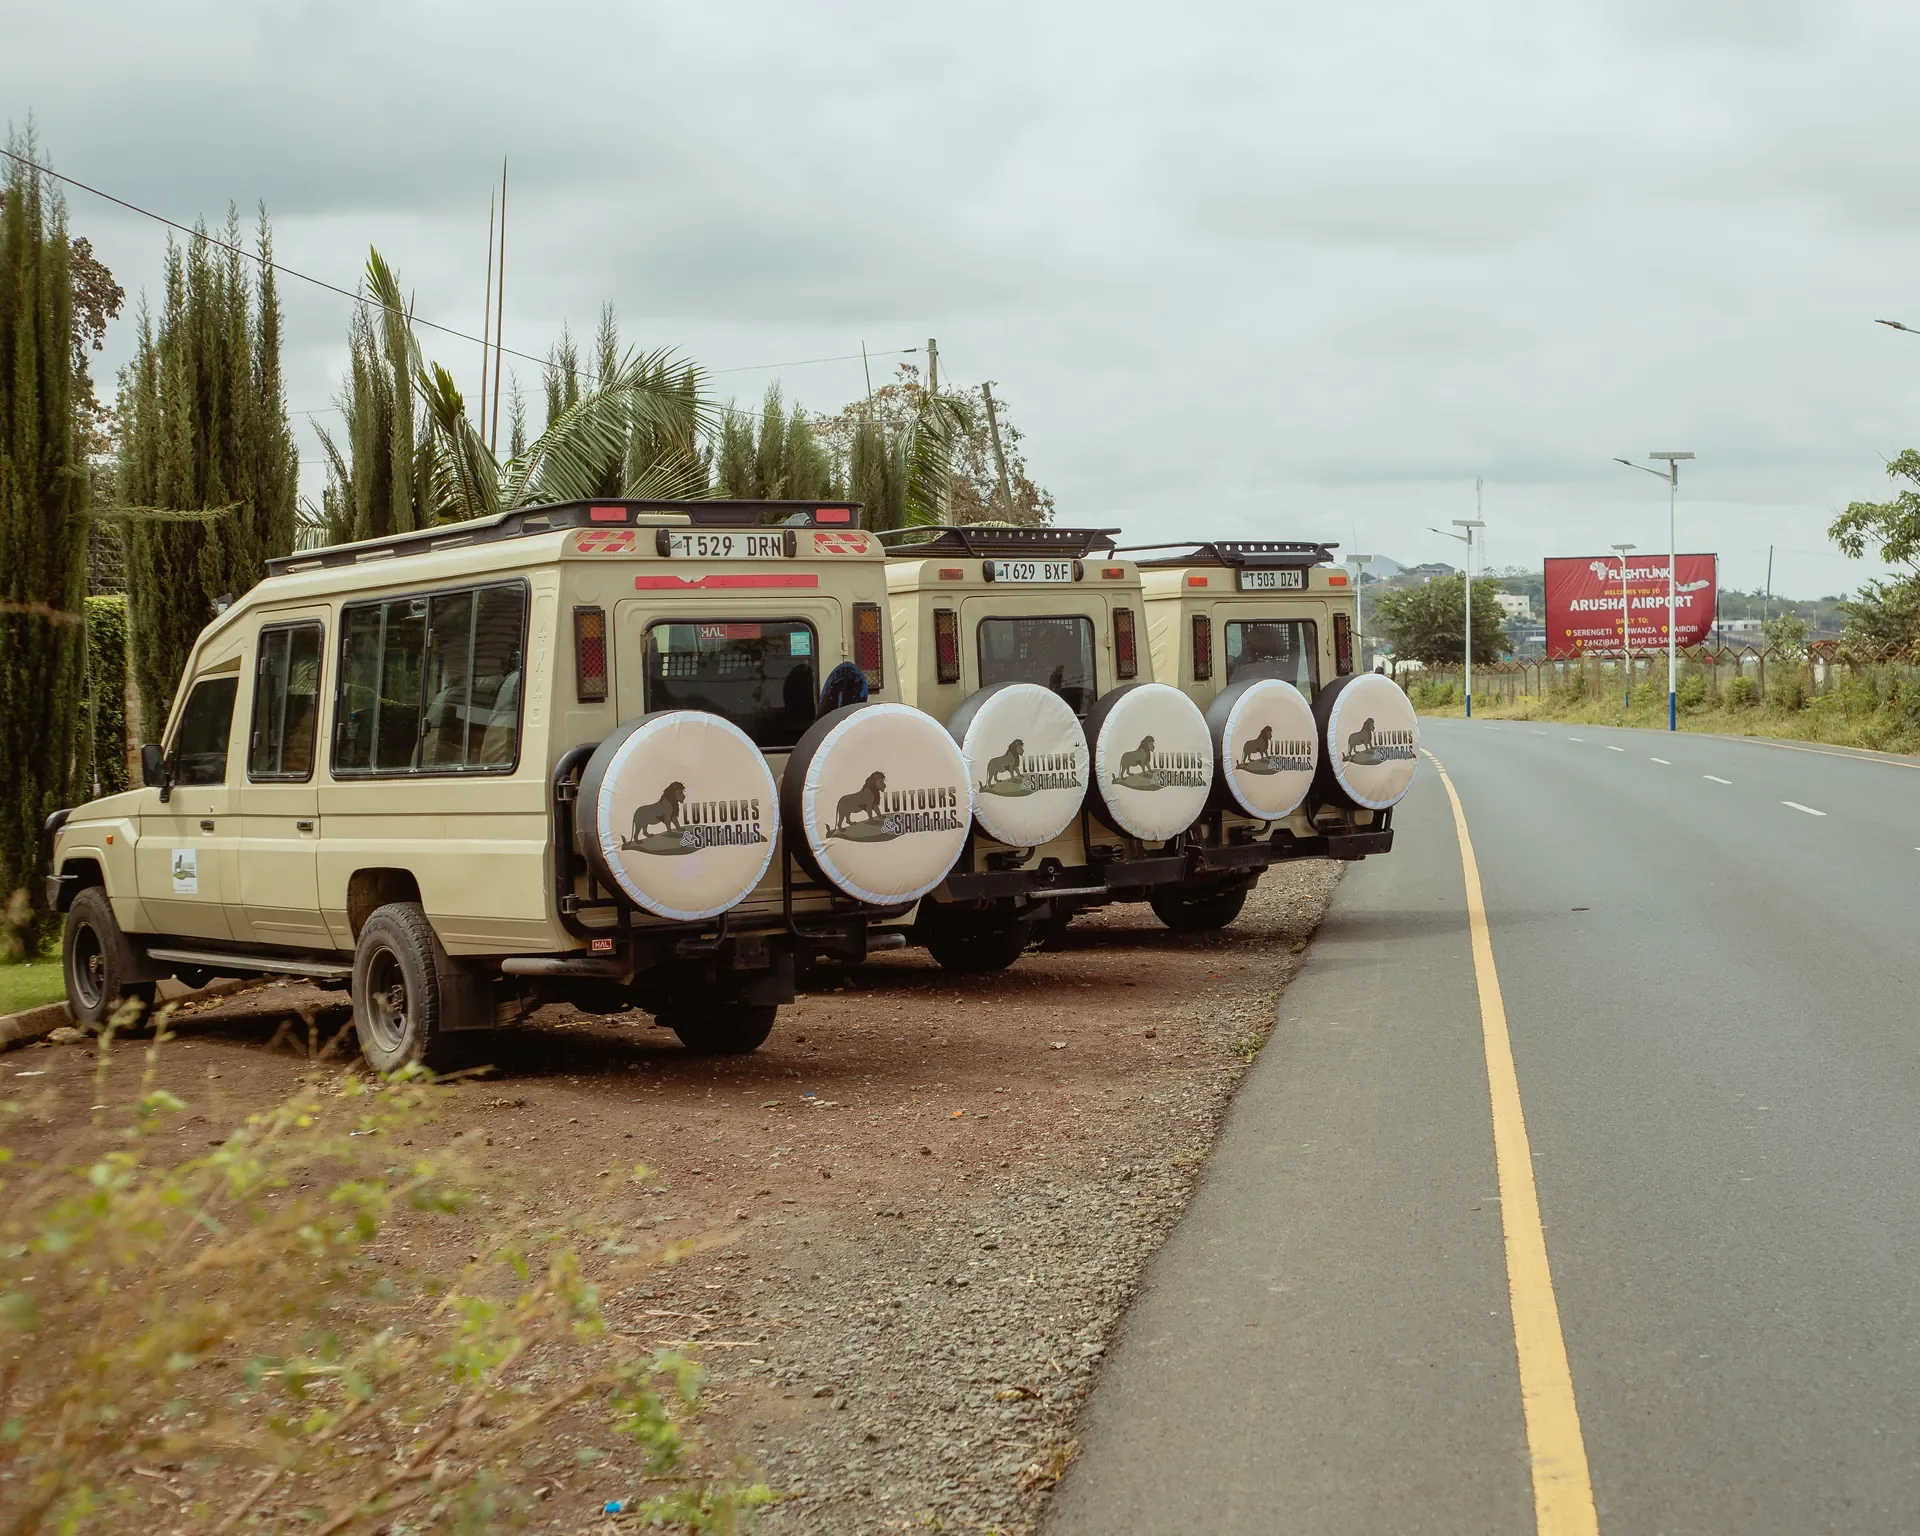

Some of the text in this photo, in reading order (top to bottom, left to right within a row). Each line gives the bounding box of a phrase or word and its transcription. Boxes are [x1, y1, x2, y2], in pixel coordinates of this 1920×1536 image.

[683, 535, 781, 557] T 529 DRN
[1003, 563, 1068, 580] T 629 BXF
[1569, 595, 1693, 612] ARUSHA AIRPORT
[1615, 617, 1635, 625] DALY
[1573, 628, 1612, 637] SERENGETI
[1674, 625, 1698, 633] AIROBI
[1583, 638, 1620, 647] ZANZIBAR
[1631, 637, 1647, 645] DAR
[1648, 636, 1658, 645] ES
[1373, 729, 1413, 746] LUITOURS
[1270, 740, 1312, 756] LUITOURS
[1022, 752, 1076, 773] LUITOURS
[1152, 752, 1203, 769] LUITOURS
[883, 786, 957, 813] LUITOURS
[682, 798, 760, 825] LUITOURS
